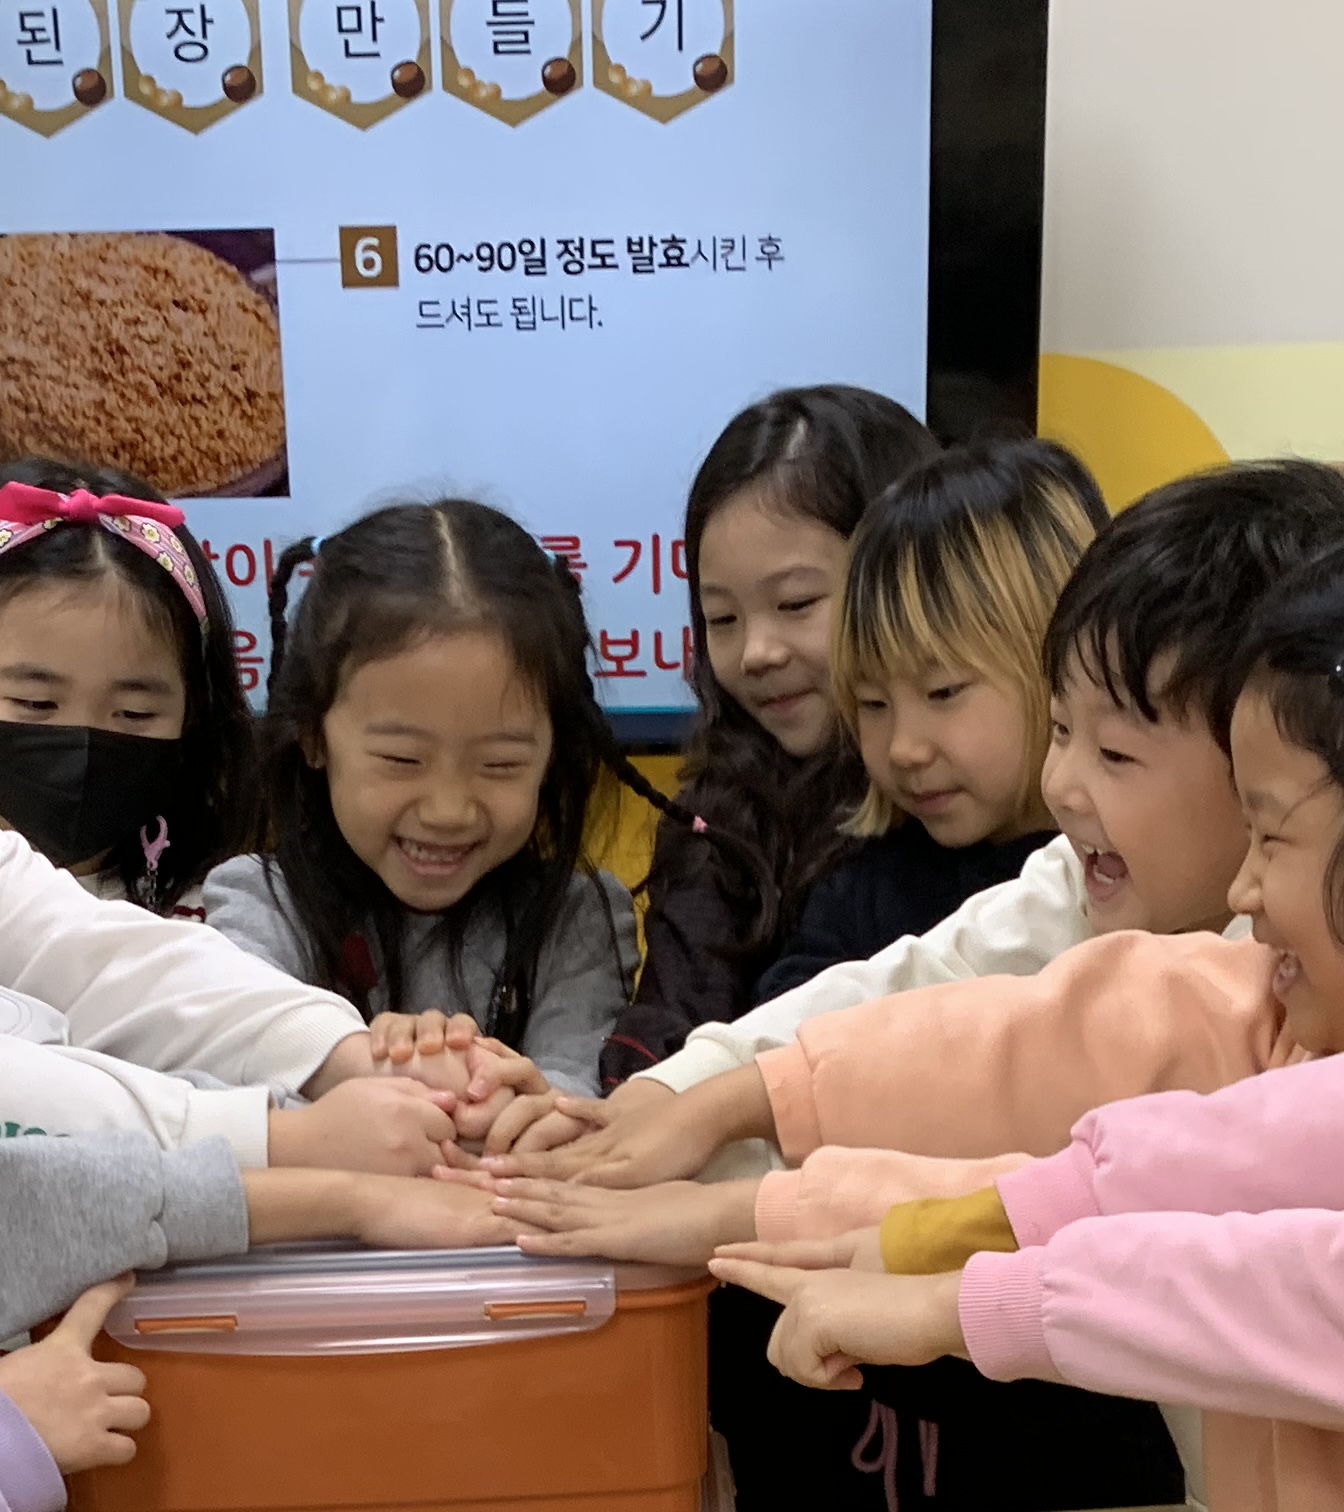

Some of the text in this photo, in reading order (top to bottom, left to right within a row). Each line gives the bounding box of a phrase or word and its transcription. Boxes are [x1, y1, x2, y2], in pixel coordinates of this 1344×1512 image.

[354, 237, 383, 278] 6
[413, 235, 786, 277] 60~90일 정도 발효시킨 후
[416, 294, 604, 331] 드셔도 됩니다.
